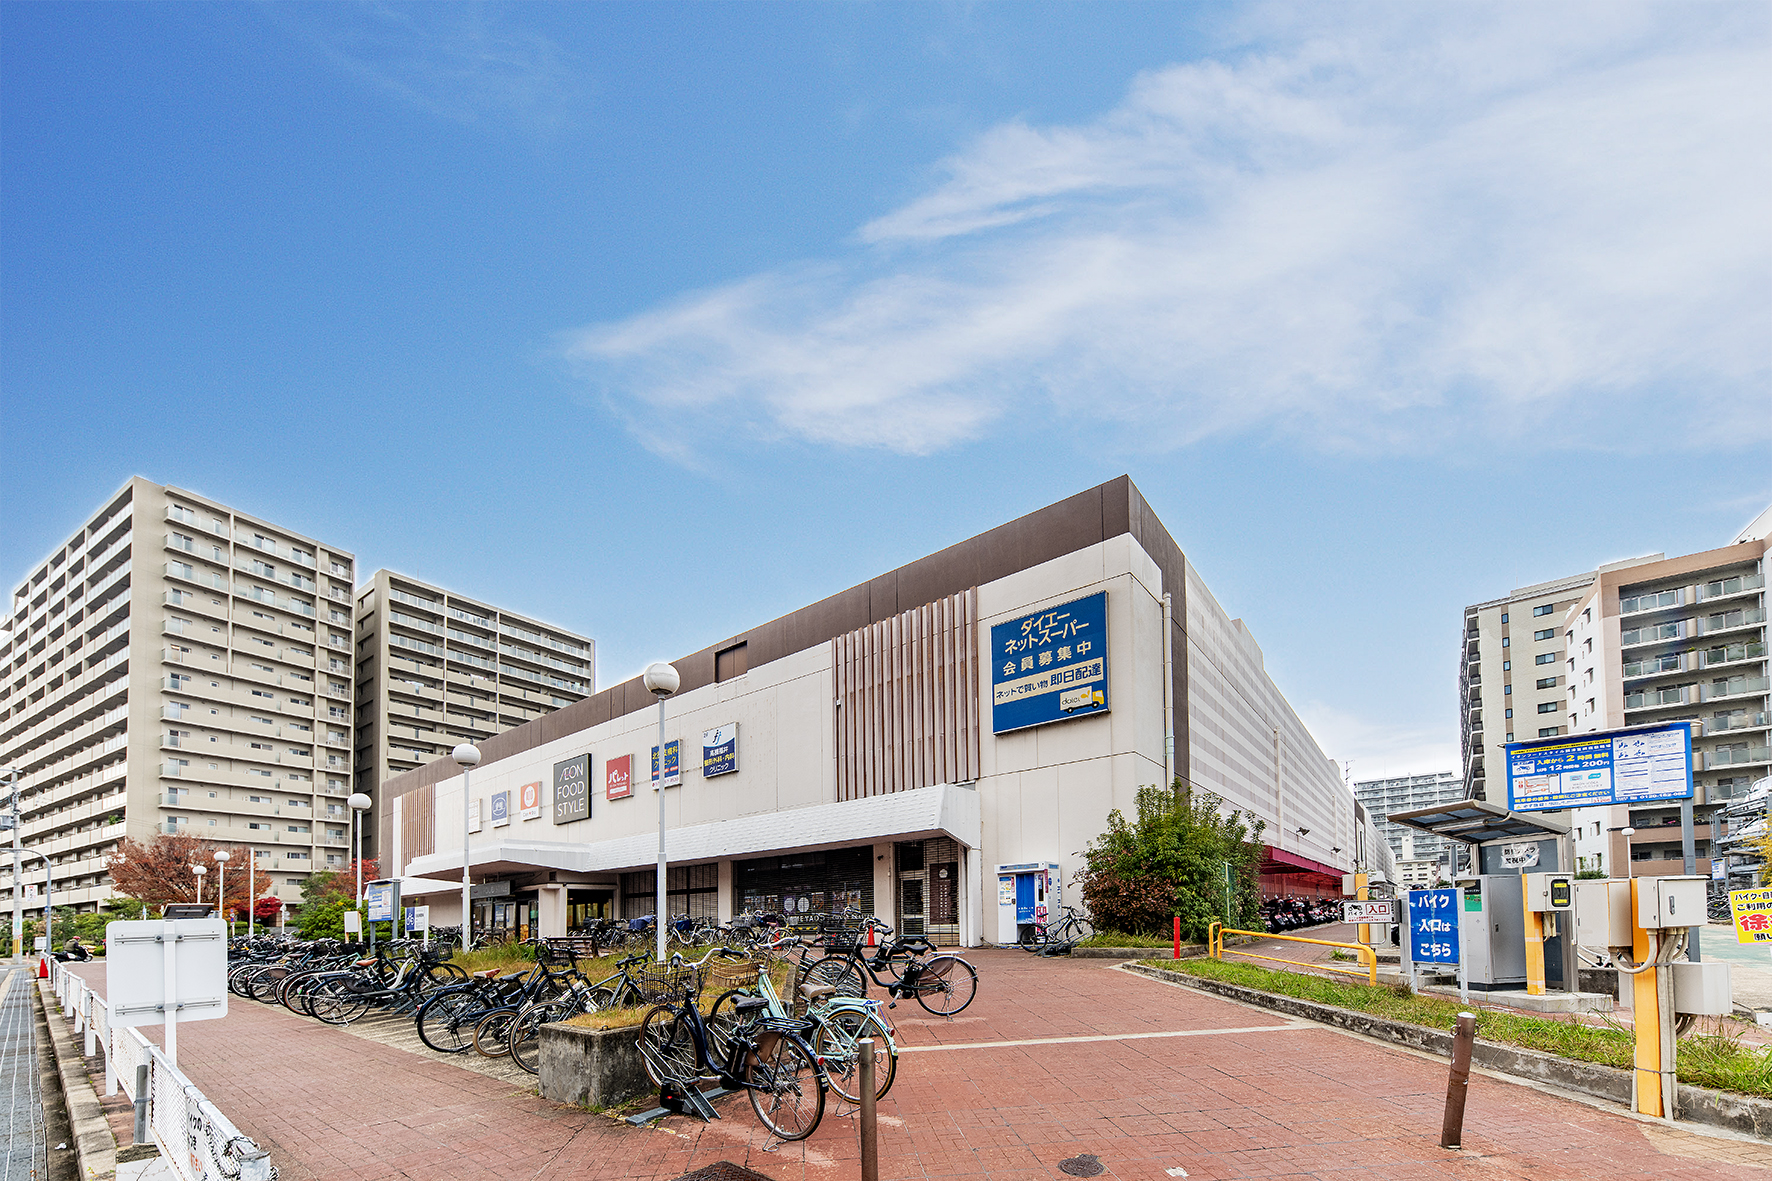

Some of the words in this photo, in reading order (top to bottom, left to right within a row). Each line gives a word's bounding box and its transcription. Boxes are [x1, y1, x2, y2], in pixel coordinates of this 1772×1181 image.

[1020, 611, 1070, 636] ダイエー
[1004, 619, 1090, 655] ネットスーパー
[1002, 640, 1092, 676] 会員募集中
[996, 680, 1049, 699] ネットで買い物
[1050, 662, 1102, 687] 即日配達
[653, 756, 676, 769] クニック
[1566, 754, 1575, 762] 2
[1581, 760, 1610, 768] 200円
[709, 763, 729, 774] クリニック
[608, 769, 629, 784] パレット
[557, 781, 585, 800] FOOD
[557, 797, 585, 817] STYLE
[1418, 894, 1450, 909] バイク
[1735, 891, 1772, 901] バイク・自
[1368, 904, 1387, 914] 入口
[1419, 918, 1452, 933] 入口は
[1739, 913, 1772, 932] 徐
[1420, 943, 1452, 957] こちら
